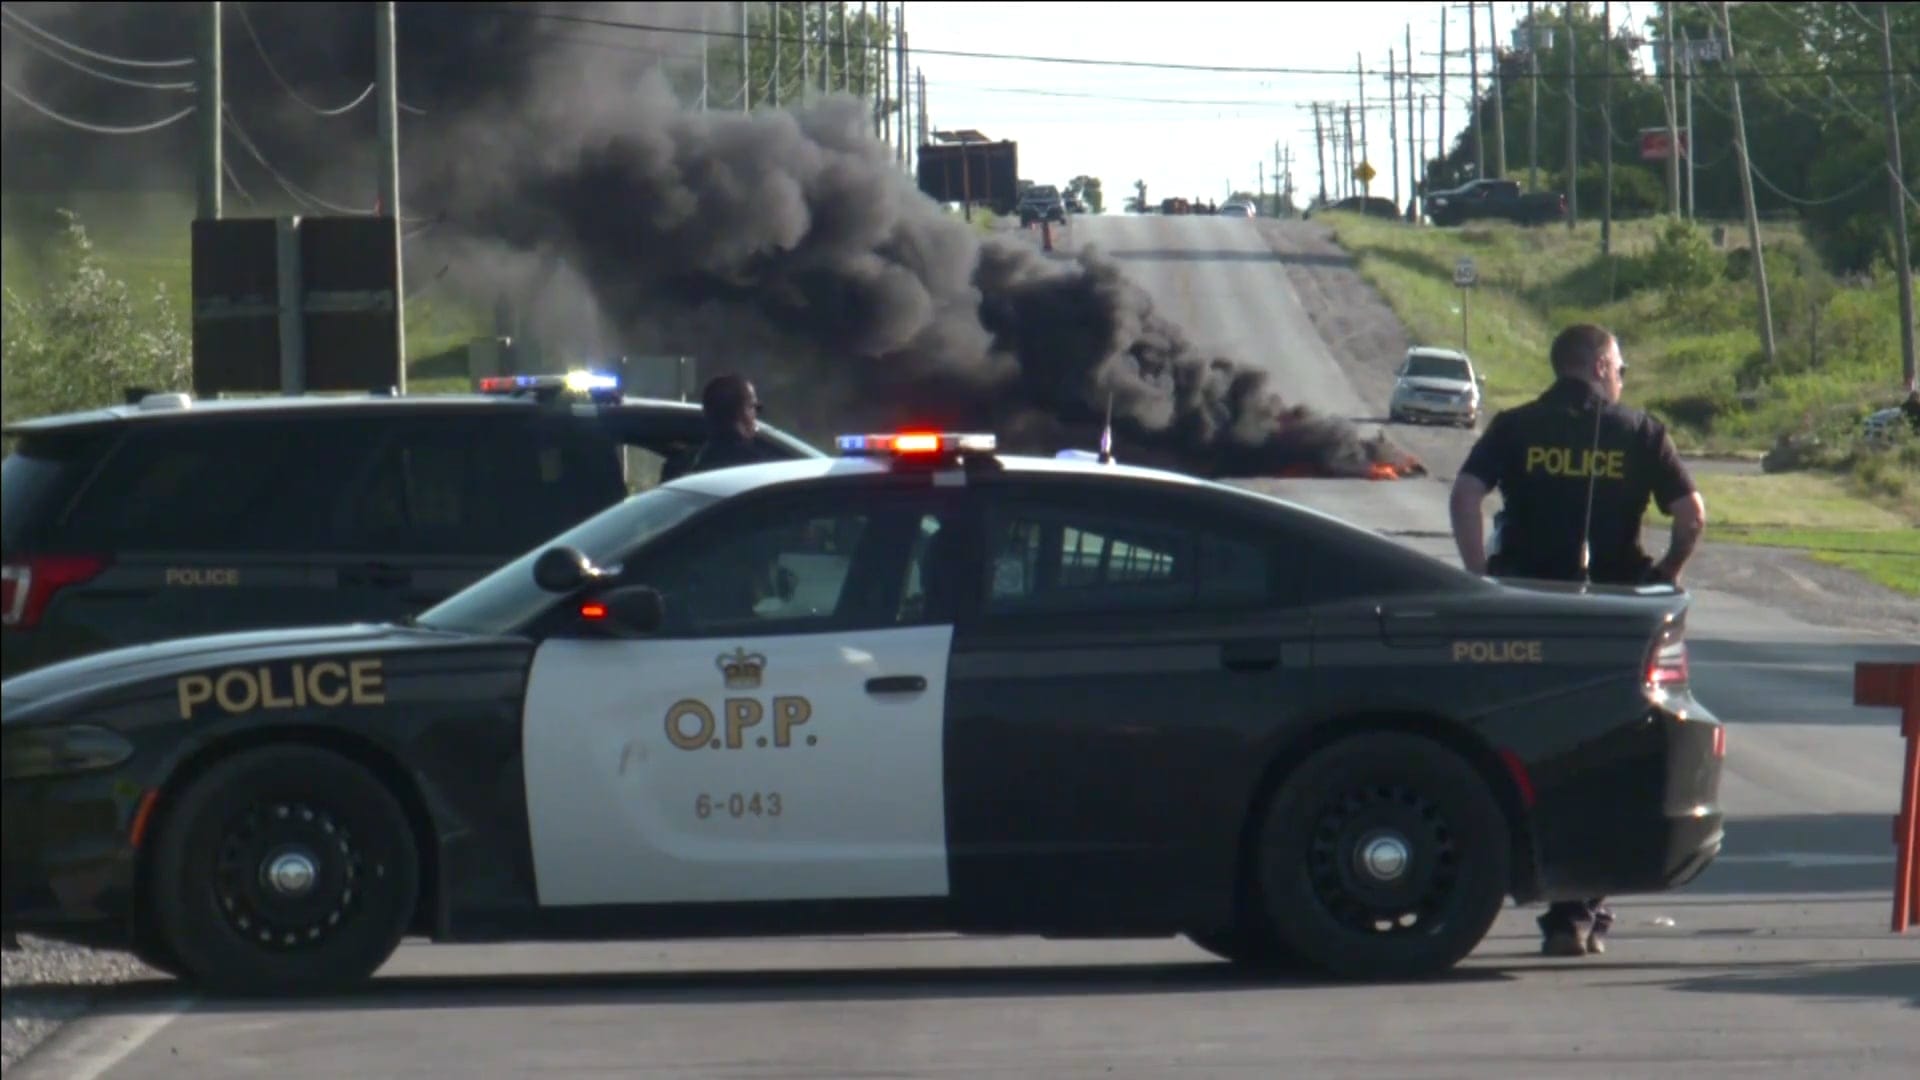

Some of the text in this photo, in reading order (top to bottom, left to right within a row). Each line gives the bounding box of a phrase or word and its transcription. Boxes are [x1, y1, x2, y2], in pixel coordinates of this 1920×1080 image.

[1526, 446, 1625, 478] POLICE
[166, 568, 240, 586] POLICE
[1453, 641, 1543, 663] POLICE
[177, 658, 386, 720] POLICE
[664, 695, 818, 751] O.P.P.
[695, 792, 782, 820] 6-043
